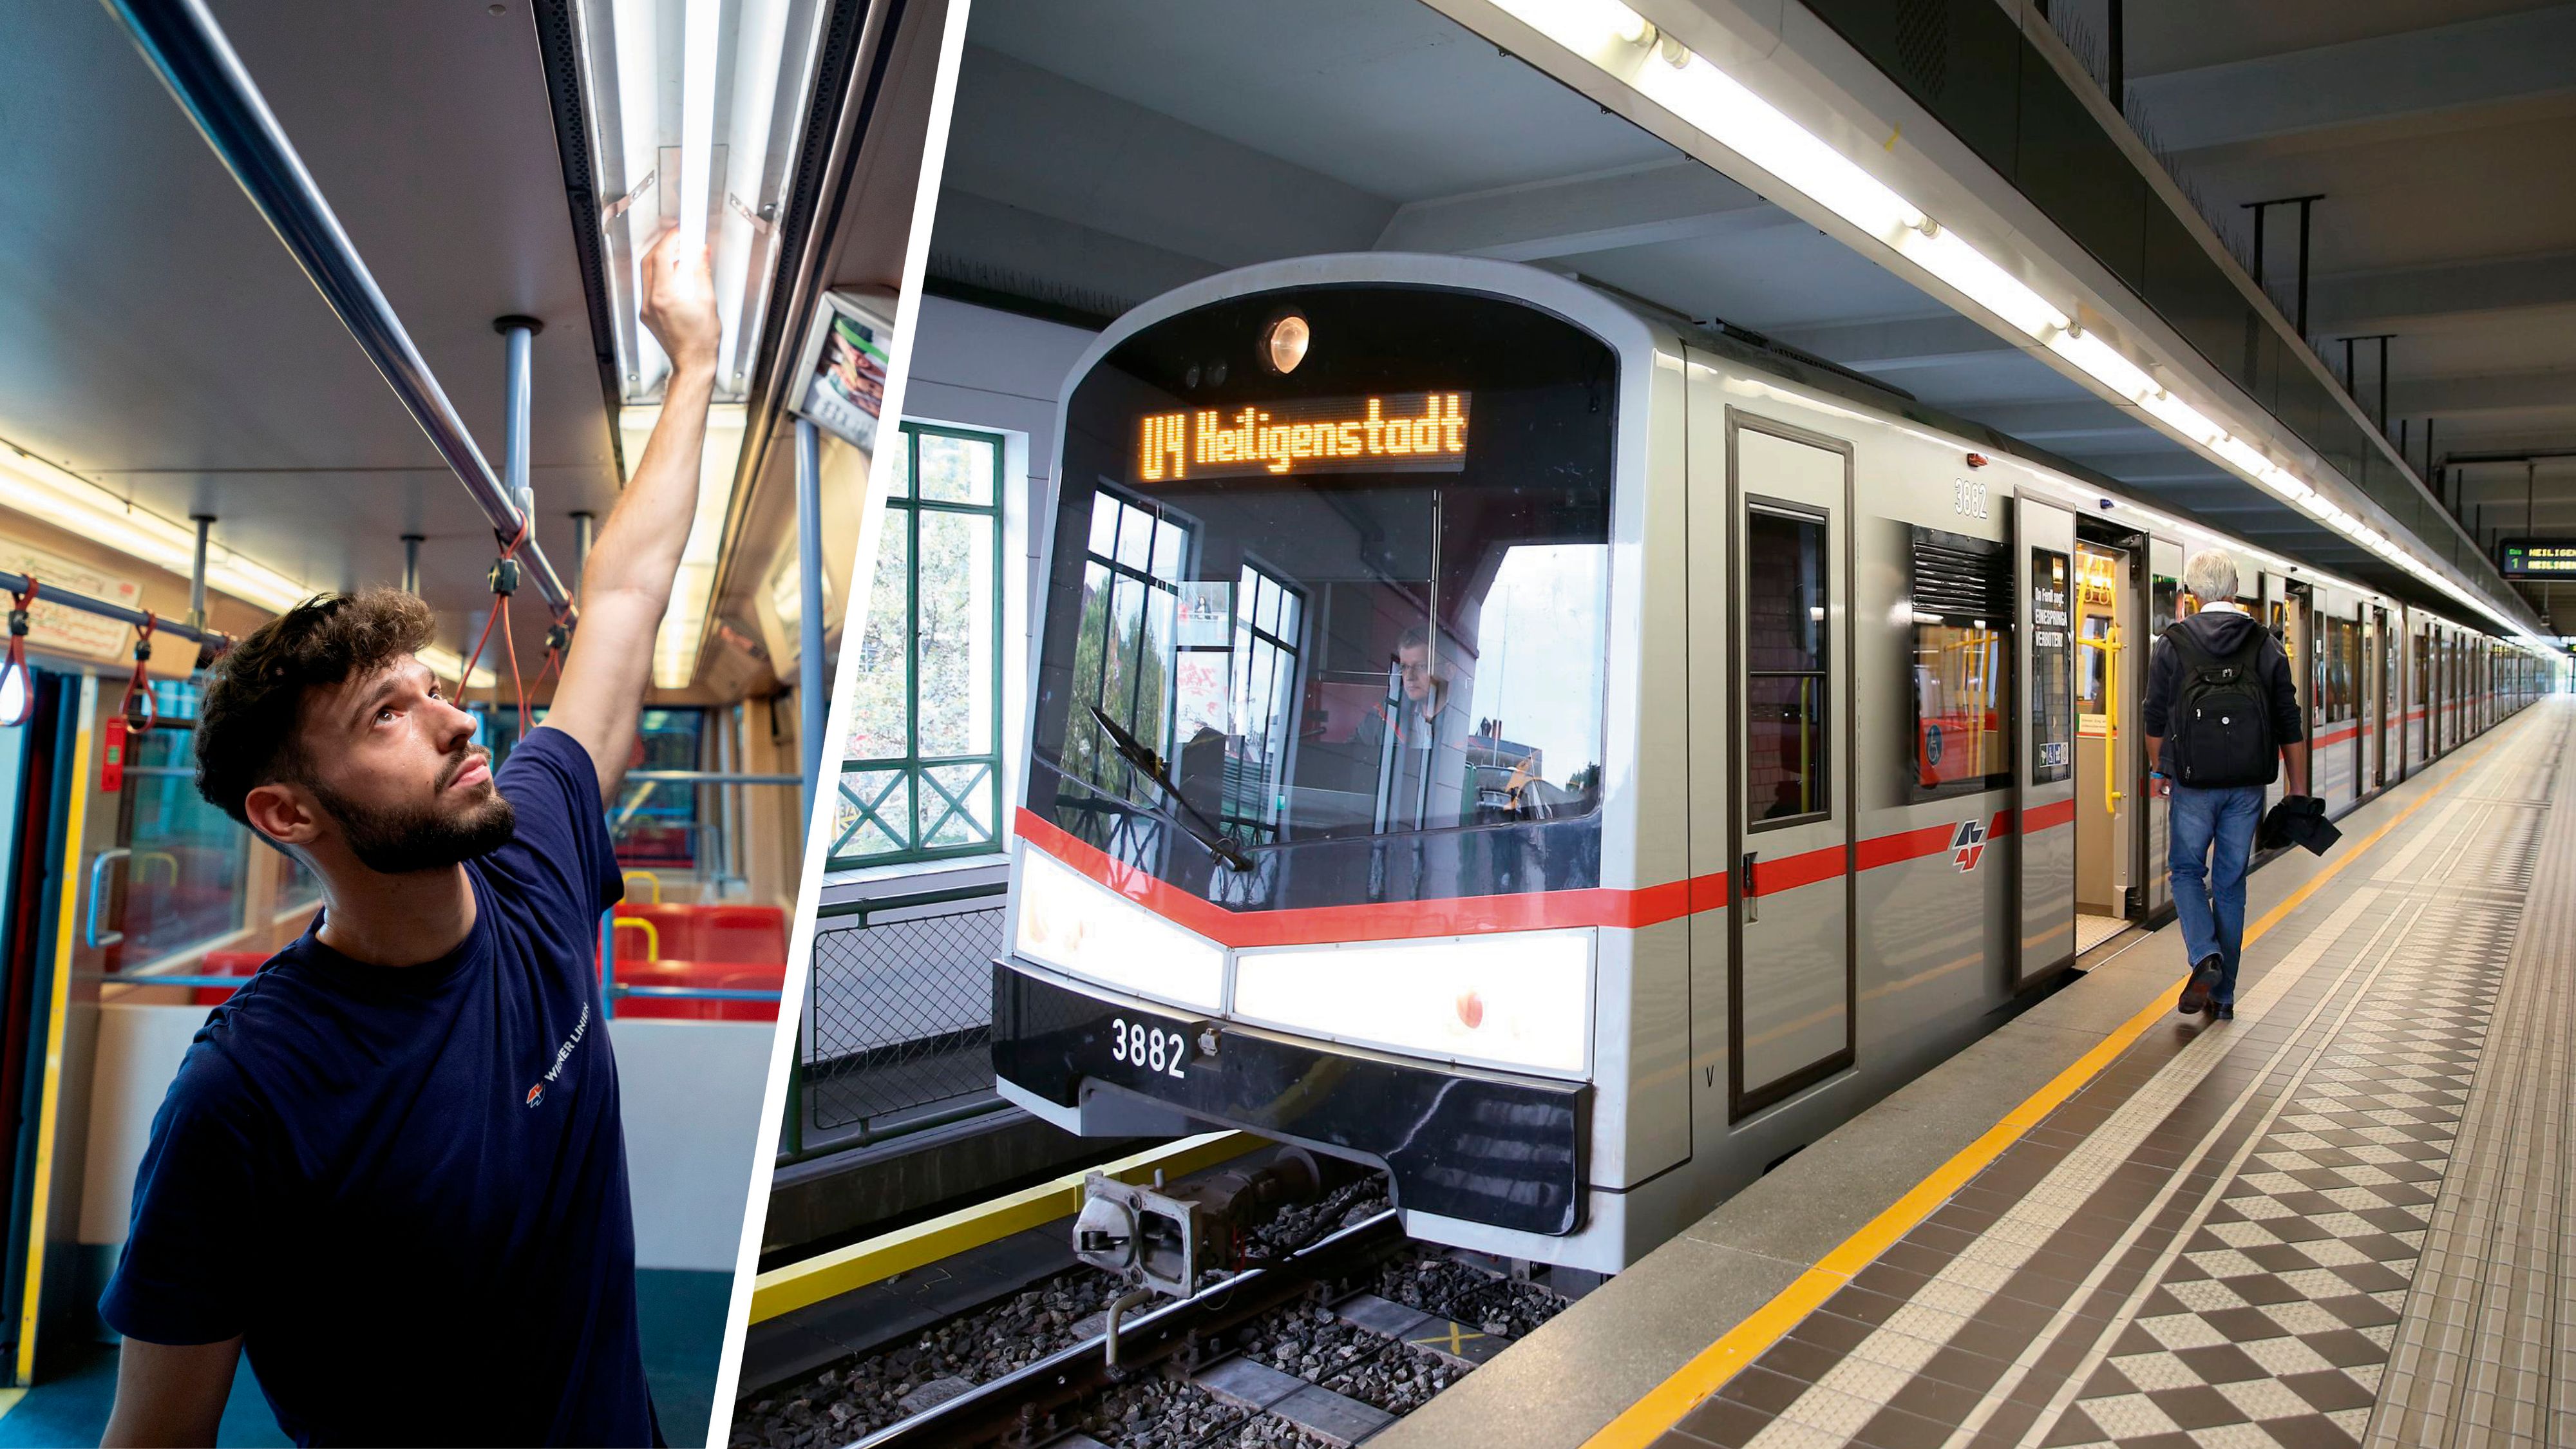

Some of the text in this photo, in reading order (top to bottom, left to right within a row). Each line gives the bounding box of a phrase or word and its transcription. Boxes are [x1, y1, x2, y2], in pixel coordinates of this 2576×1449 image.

[1143, 395, 1464, 480] U4 Heiligenstadt
[1954, 477, 1987, 520] 3882
[544, 1001, 589, 1082] WIENER LINIEN
[1112, 1018, 1185, 1079] 3882
